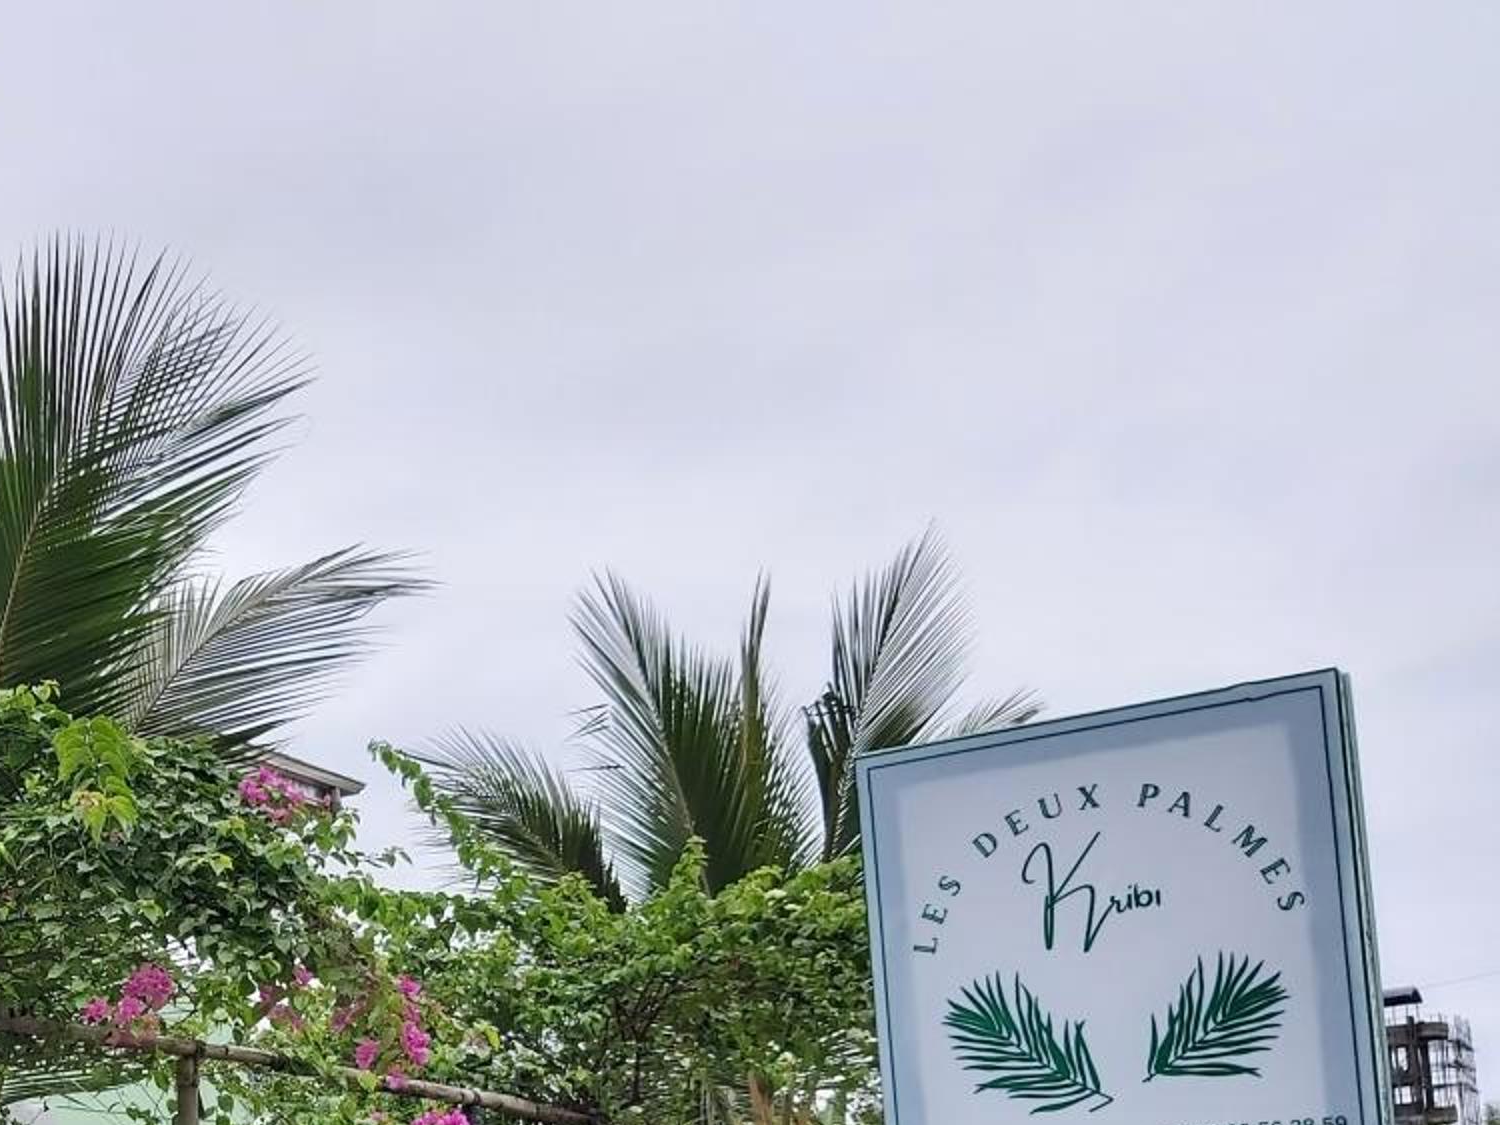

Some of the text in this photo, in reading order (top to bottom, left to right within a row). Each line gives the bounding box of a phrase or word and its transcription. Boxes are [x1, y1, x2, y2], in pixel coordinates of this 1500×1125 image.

[913, 783, 1305, 955] LES DEUX PALMES
[1021, 831, 1161, 953] Kribi
